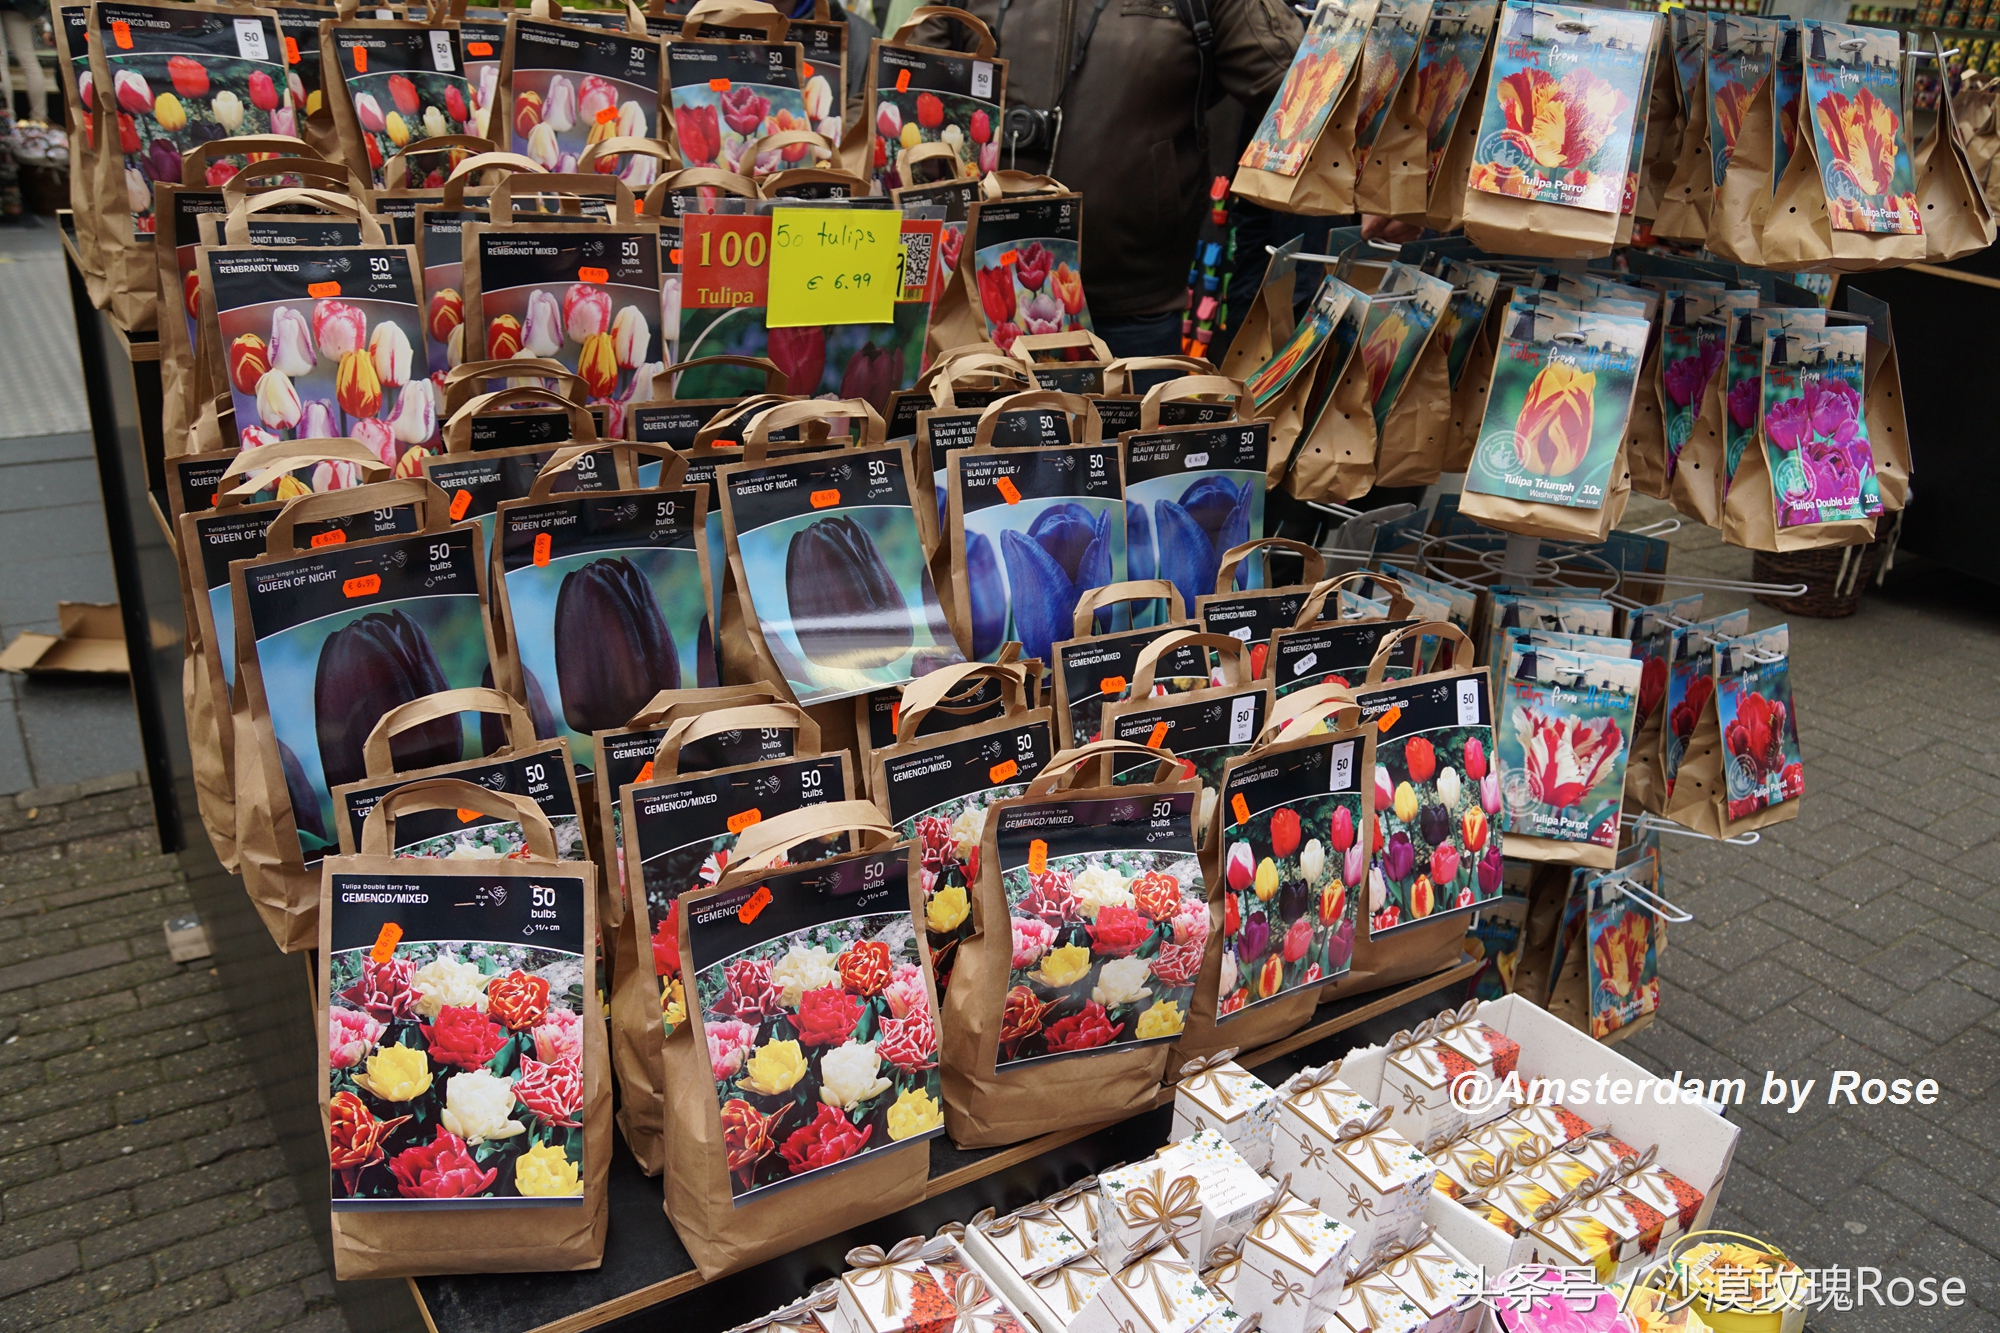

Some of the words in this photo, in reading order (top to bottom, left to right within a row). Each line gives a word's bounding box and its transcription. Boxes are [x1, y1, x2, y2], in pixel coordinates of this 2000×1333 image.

[244, 32, 259, 42] 50
[522, 33, 558, 48] REMBRANDT
[560, 39, 580, 52] MIXED
[815, 30, 829, 41] 50
[437, 43, 447, 53] 50
[630, 47, 645, 61] 50
[769, 51, 783, 64] 50
[978, 73, 988, 84] 50
[1810, 63, 1837, 88] Tulips
[1839, 65, 1860, 89] from
[1522, 174, 1552, 189] Tulipa
[1554, 180, 1587, 193] Parrot
[962, 189, 971, 199] 50
[1603, 188, 1616, 199] 7x
[1060, 205, 1070, 215] 50
[1859, 206, 1879, 219] Tulipa
[1880, 207, 1901, 219] Parrot
[1909, 210, 1919, 221] 7x
[983, 213, 1019, 222] GEMENGD/MIXED
[817, 221, 876, 249] tulips
[488, 247, 534, 256] REMBRANDT
[535, 247, 559, 256] MIXED
[622, 242, 639, 257] 50
[699, 230, 766, 267] 100
[220, 264, 271, 275] REMBRANDT
[273, 264, 300, 273] MIXED
[370, 256, 390, 273] 50
[807, 275, 823, 290] €
[834, 273, 872, 291] 6.99
[697, 287, 755, 308] Tulipa
[1508, 342, 1540, 367] Tulips
[1547, 347, 1576, 368] from
[1769, 368, 1794, 391] Tulips
[1799, 366, 1820, 389] from
[1040, 415, 1054, 428] 50
[1199, 410, 1213, 420] 50
[642, 421, 666, 431] QUEEN
[667, 420, 679, 429] OF
[680, 419, 699, 429] NIGHT
[935, 428, 955, 436] BLAUW
[474, 431, 497, 439] NIGHT
[936, 438, 951, 446] BLAU
[958, 436, 973, 444] BLEU
[1240, 431, 1255, 445] 50
[577, 455, 595, 470] 50
[868, 460, 885, 476] 50
[1090, 454, 1103, 468] 50
[685, 472, 711, 482] QUEEN
[967, 468, 992, 476] BLAUW
[998, 466, 1015, 474] BLUE
[190, 476, 220, 487] QUEEN
[440, 477, 468, 488] QUEEN
[470, 476, 480, 486] OF
[483, 474, 501, 483] NIGHT
[737, 484, 763, 496] QUEEN
[764, 482, 775, 492] OF
[776, 478, 798, 489] NIGHT
[1504, 473, 1533, 488] Tulipa
[1535, 478, 1575, 493] Triumph
[1529, 489, 1572, 503] Washington
[1583, 484, 1601, 496] 10x
[1790, 500, 1815, 512] Tulipa
[1816, 498, 1842, 509] Double
[1844, 496, 1860, 505] Late
[1865, 494, 1879, 504] 10x
[657, 501, 674, 516] 50
[1822, 509, 1834, 518] Blue
[512, 521, 539, 531] QUEEN
[541, 519, 552, 528] OF
[554, 516, 577, 526] NIGHT
[429, 543, 450, 561] 50
[256, 574, 275, 582] Tulipa
[276, 571, 294, 579] Single
[295, 568, 309, 577] Late
[310, 564, 324, 574] Type
[258, 579, 291, 594] QUEEN
[293, 577, 305, 588] OF
[309, 570, 337, 585] NIGHT
[1209, 610, 1257, 621] GEMENGD/MIXED
[1282, 640, 1332, 654] GEMENGD/MIXED
[1650, 636, 1664, 652] from
[1069, 652, 1121, 668] GEMENGD/MIXED
[1463, 693, 1474, 704] 50
[1513, 681, 1544, 706] Tulips
[1551, 686, 1578, 707] from
[1582, 685, 1631, 711] Holland
[1236, 711, 1249, 723] 50
[1017, 734, 1032, 751] 50
[893, 760, 952, 782] GEMENGD/MIXED
[1337, 758, 1348, 771] 50
[525, 764, 545, 783] 50
[801, 769, 821, 788] 50
[1231, 769, 1279, 788] GEMENGD/MIXED
[1793, 774, 1802, 783] 7x
[1753, 785, 1770, 799] Tulipa
[1770, 779, 1787, 793] Parrot
[355, 797, 374, 805] Tulipa
[644, 794, 717, 815] GEMENGD/MIXED
[1152, 802, 1171, 818] 50
[1005, 815, 1074, 829] GEMENGD/MIXED
[1531, 813, 1558, 827] Tulipa
[1560, 817, 1589, 830] Parrot
[1602, 822, 1614, 833] 7x
[1536, 825, 1560, 835] Estella
[1561, 829, 1588, 840] Rijnveld
[864, 861, 884, 880] 50
[342, 893, 429, 903] GEMENGD/MIXED
[532, 888, 556, 906] 50
